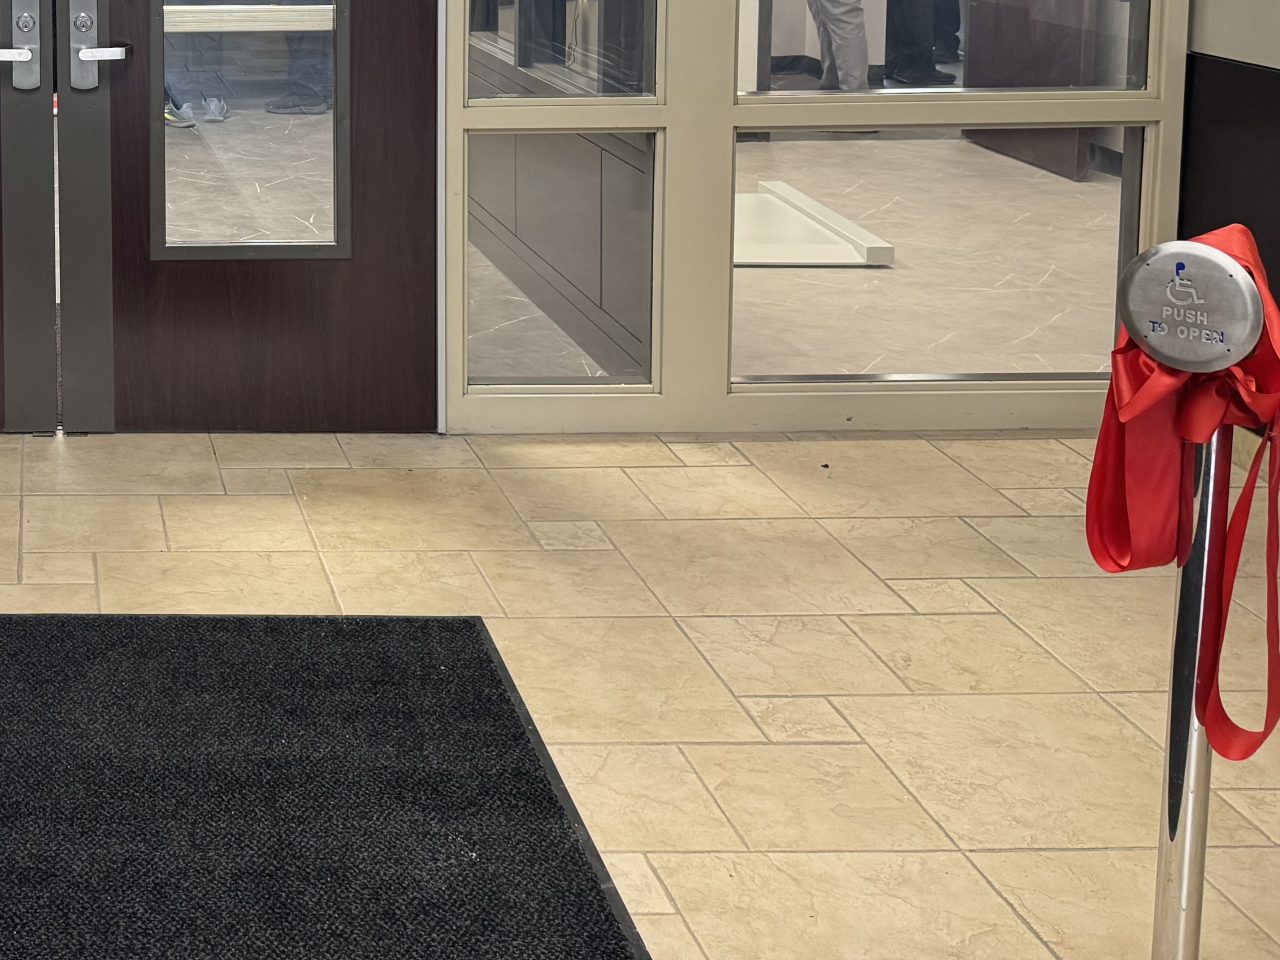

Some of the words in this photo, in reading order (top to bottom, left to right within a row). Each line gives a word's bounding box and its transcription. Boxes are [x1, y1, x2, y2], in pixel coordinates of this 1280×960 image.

[1162, 306, 1208, 325] PUSH
[1148, 320, 1169, 335] TO
[1176, 325, 1225, 344] OPEN
